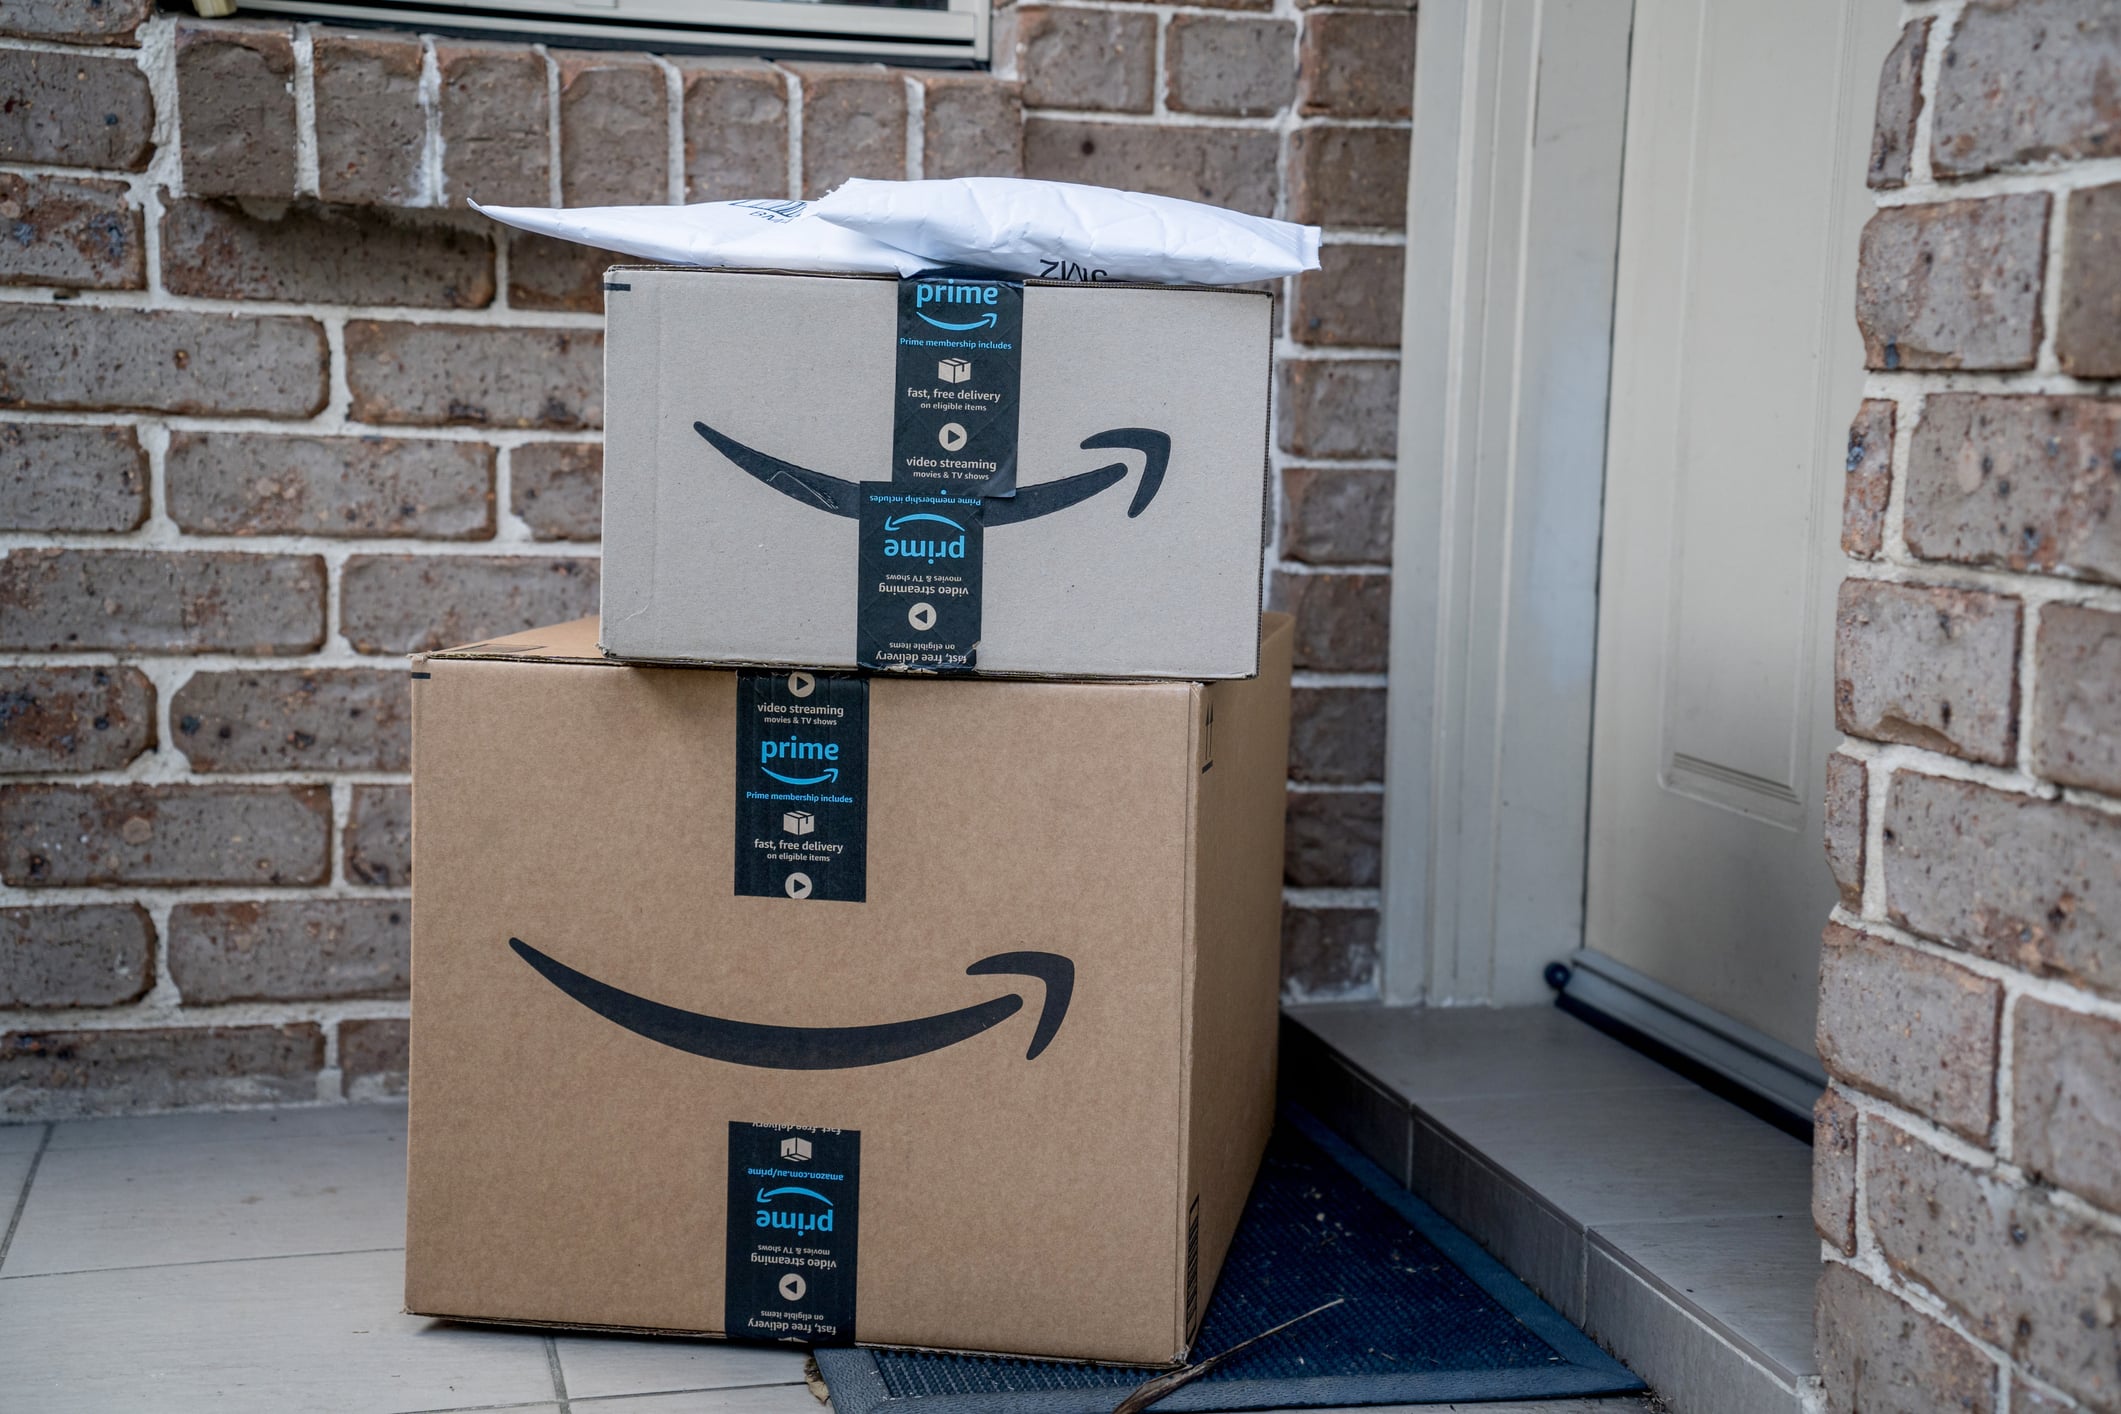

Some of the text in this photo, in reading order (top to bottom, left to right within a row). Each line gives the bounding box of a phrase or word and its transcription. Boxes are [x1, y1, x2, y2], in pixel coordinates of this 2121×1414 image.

[916, 279, 998, 308] prime
[900, 338, 1012, 350] Prime membership includes
[907, 388, 1001, 402] fast, free delivery
[933, 403, 962, 411] eligible
[906, 457, 997, 471] video streaming
[964, 472, 989, 480] shows
[869, 495, 903, 503] includes
[905, 496, 956, 504] membership
[884, 536, 965, 564] prime
[878, 583, 968, 596] video streaming
[913, 642, 943, 651] eligible
[875, 651, 967, 664] fast, free delivery
[757, 703, 844, 717] video streaming
[761, 736, 839, 763] prime
[746, 792, 853, 803] Prime membership includes
[754, 839, 843, 854] fast, free delivery
[779, 853, 807, 862] eligible
[809, 854, 830, 862] items
[748, 1168, 844, 1181] amazon.com.au/prime
[756, 1210, 833, 1236] prime
[803, 1248, 830, 1256] movies
[750, 1253, 837, 1269] video streaming
[760, 1311, 782, 1319] items
[783, 1312, 812, 1321] eligible
[747, 1318, 836, 1335] fast, free delivery
